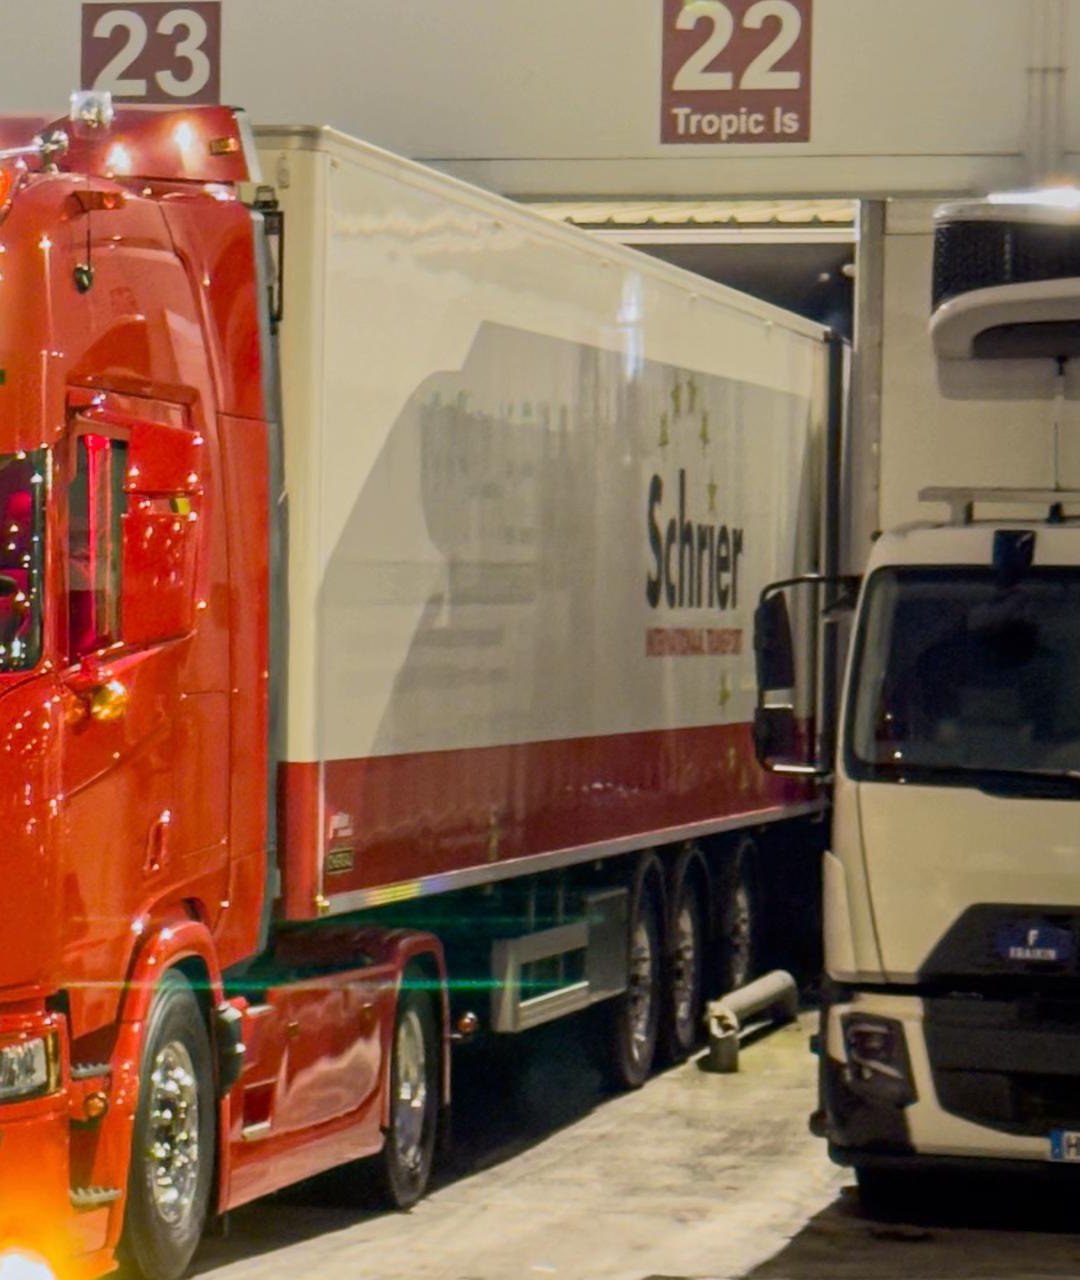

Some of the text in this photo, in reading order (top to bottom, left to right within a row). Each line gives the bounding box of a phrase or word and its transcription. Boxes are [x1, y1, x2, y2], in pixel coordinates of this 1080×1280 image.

[91, 8, 211, 98] 23
[672, 0, 802, 91] 22
[671, 106, 766, 141] Tropic
[645, 468, 745, 610] Schrier
